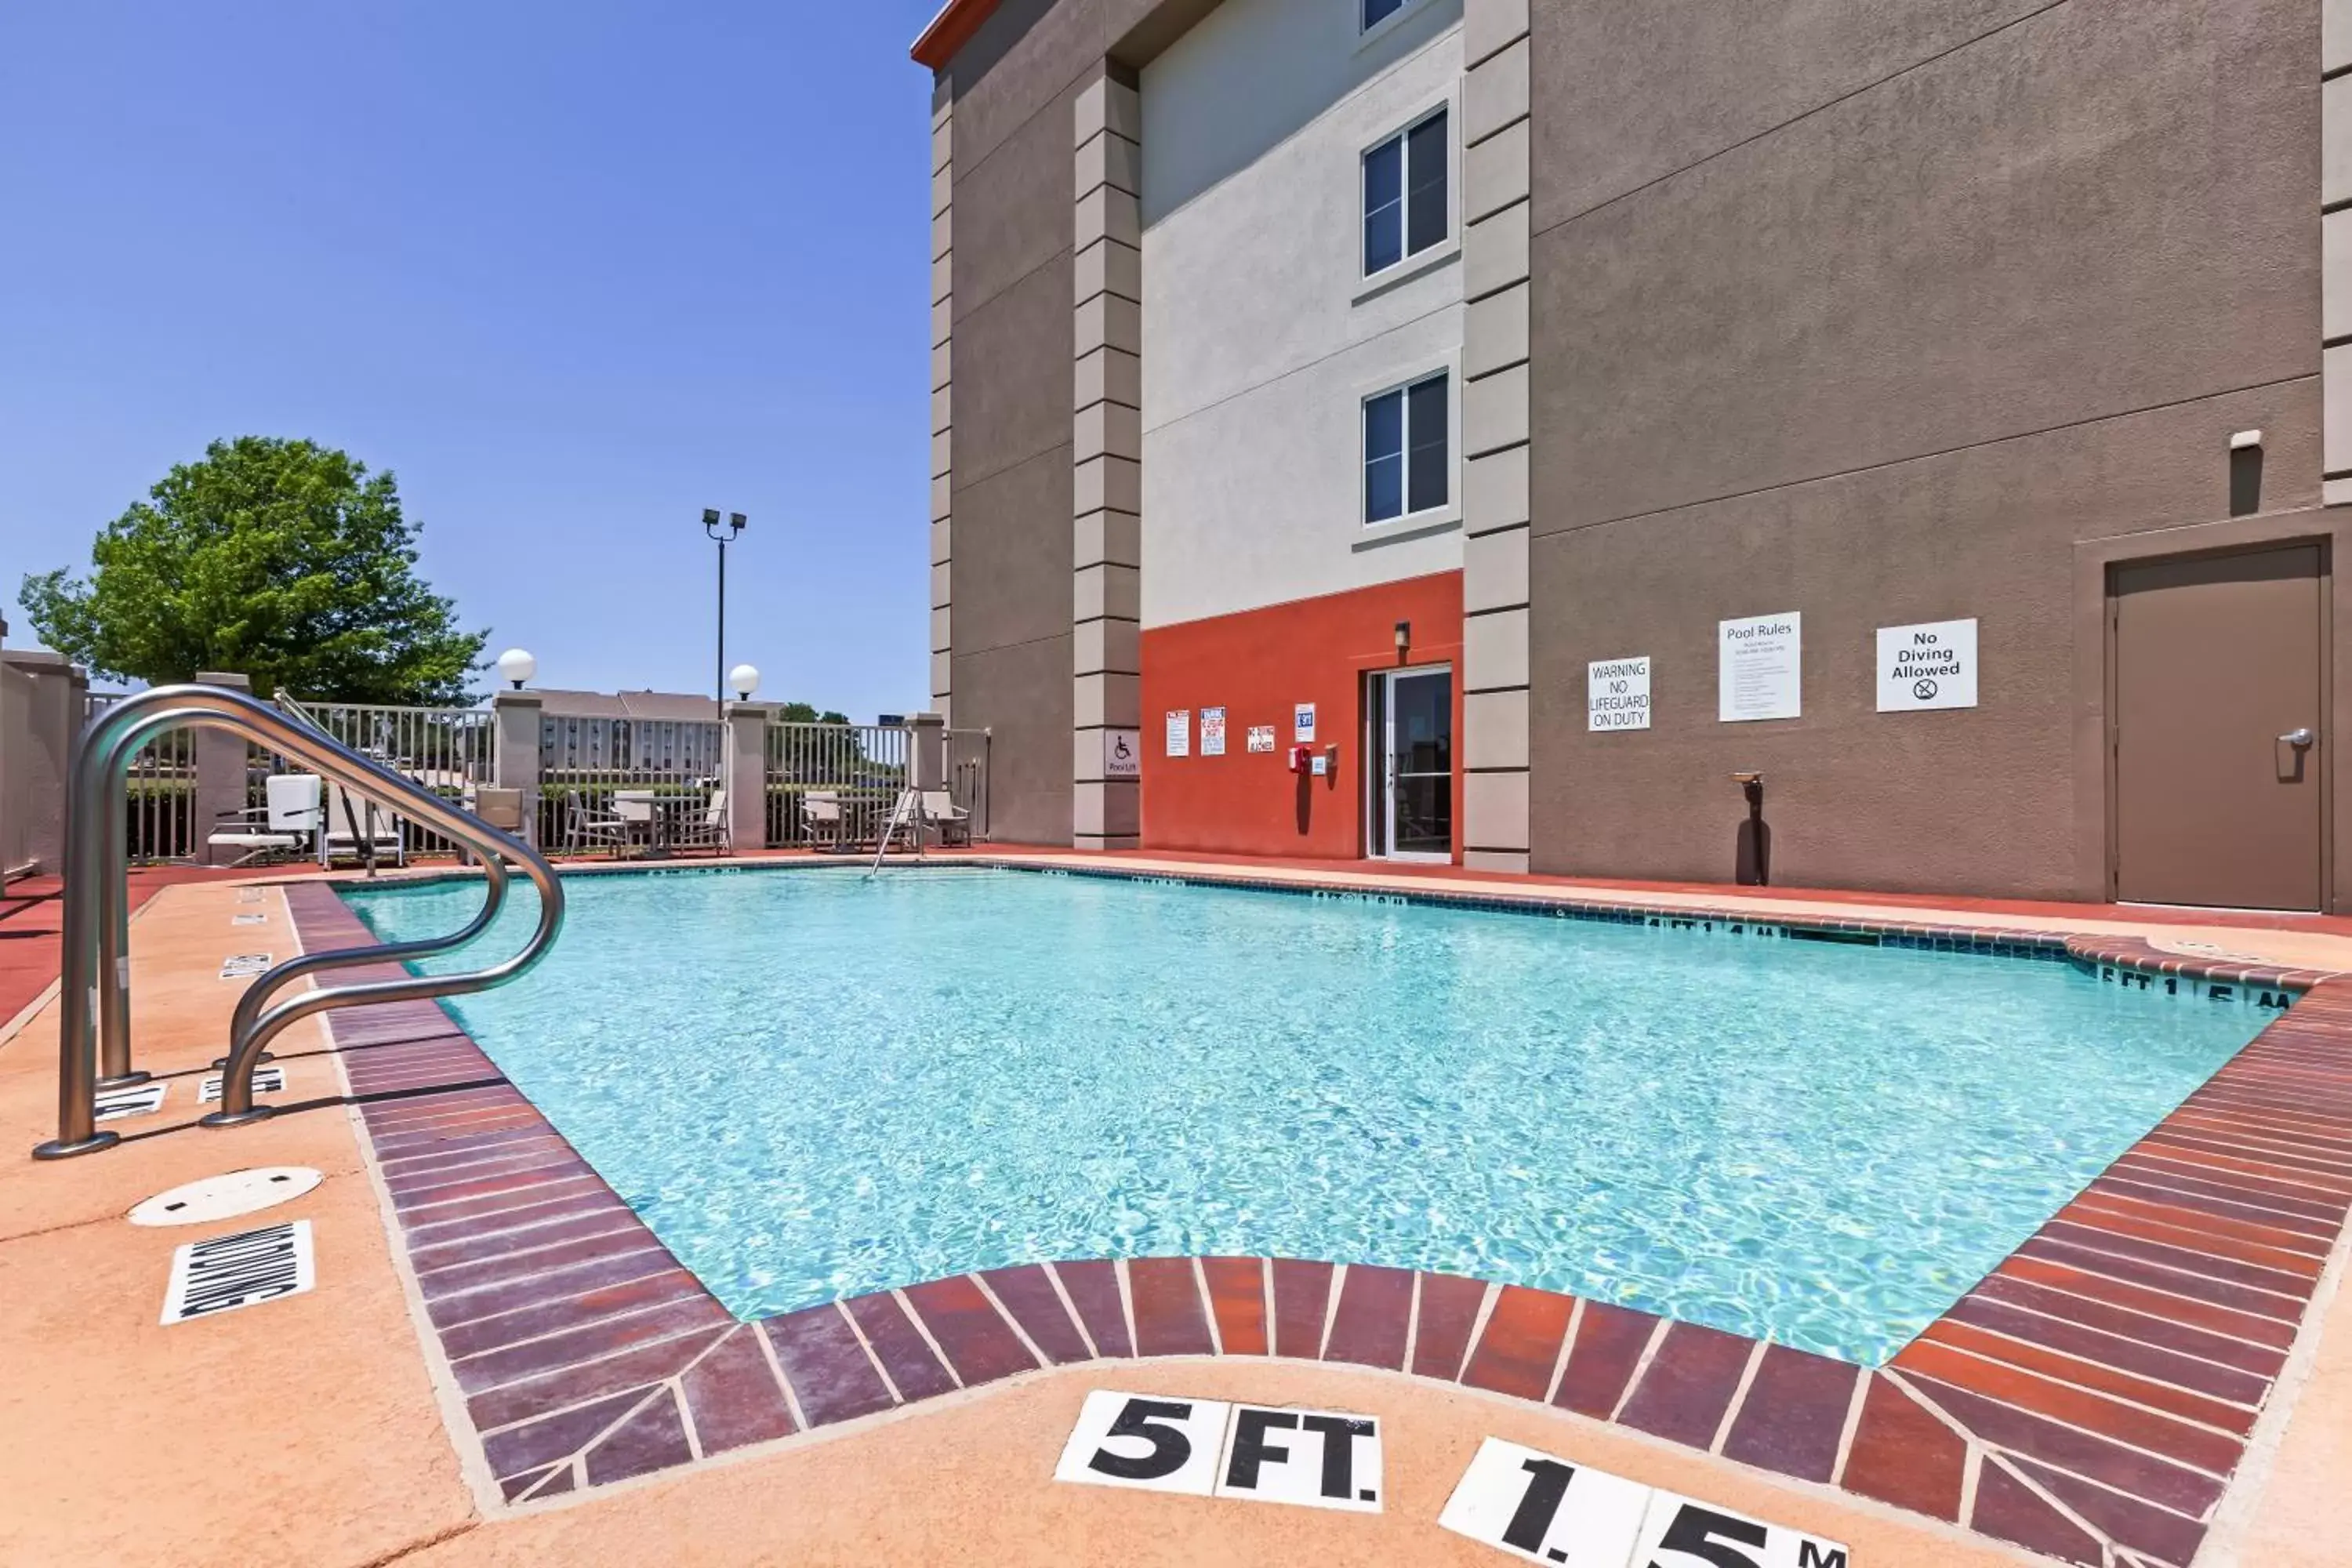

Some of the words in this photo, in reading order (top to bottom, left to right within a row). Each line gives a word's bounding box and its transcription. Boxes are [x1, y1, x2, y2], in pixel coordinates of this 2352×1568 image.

[1727, 627, 1754, 639] Pool
[1759, 623, 1791, 637] Rules
[1914, 633, 1937, 644] No
[1898, 648, 1953, 662] Diving
[1592, 662, 1646, 679] WARNING
[1892, 661, 1959, 680] Allowed
[1610, 680, 1628, 694] NO
[1590, 694, 1649, 711] LIFEGUARD
[1594, 713, 1611, 727] ON
[1615, 711, 1645, 726] DUTY
[191, 1223, 296, 1258] NO
[180, 1242, 298, 1318] DIVING
[1087, 1398, 1192, 1479] 5
[1225, 1408, 1376, 1502] FT.
